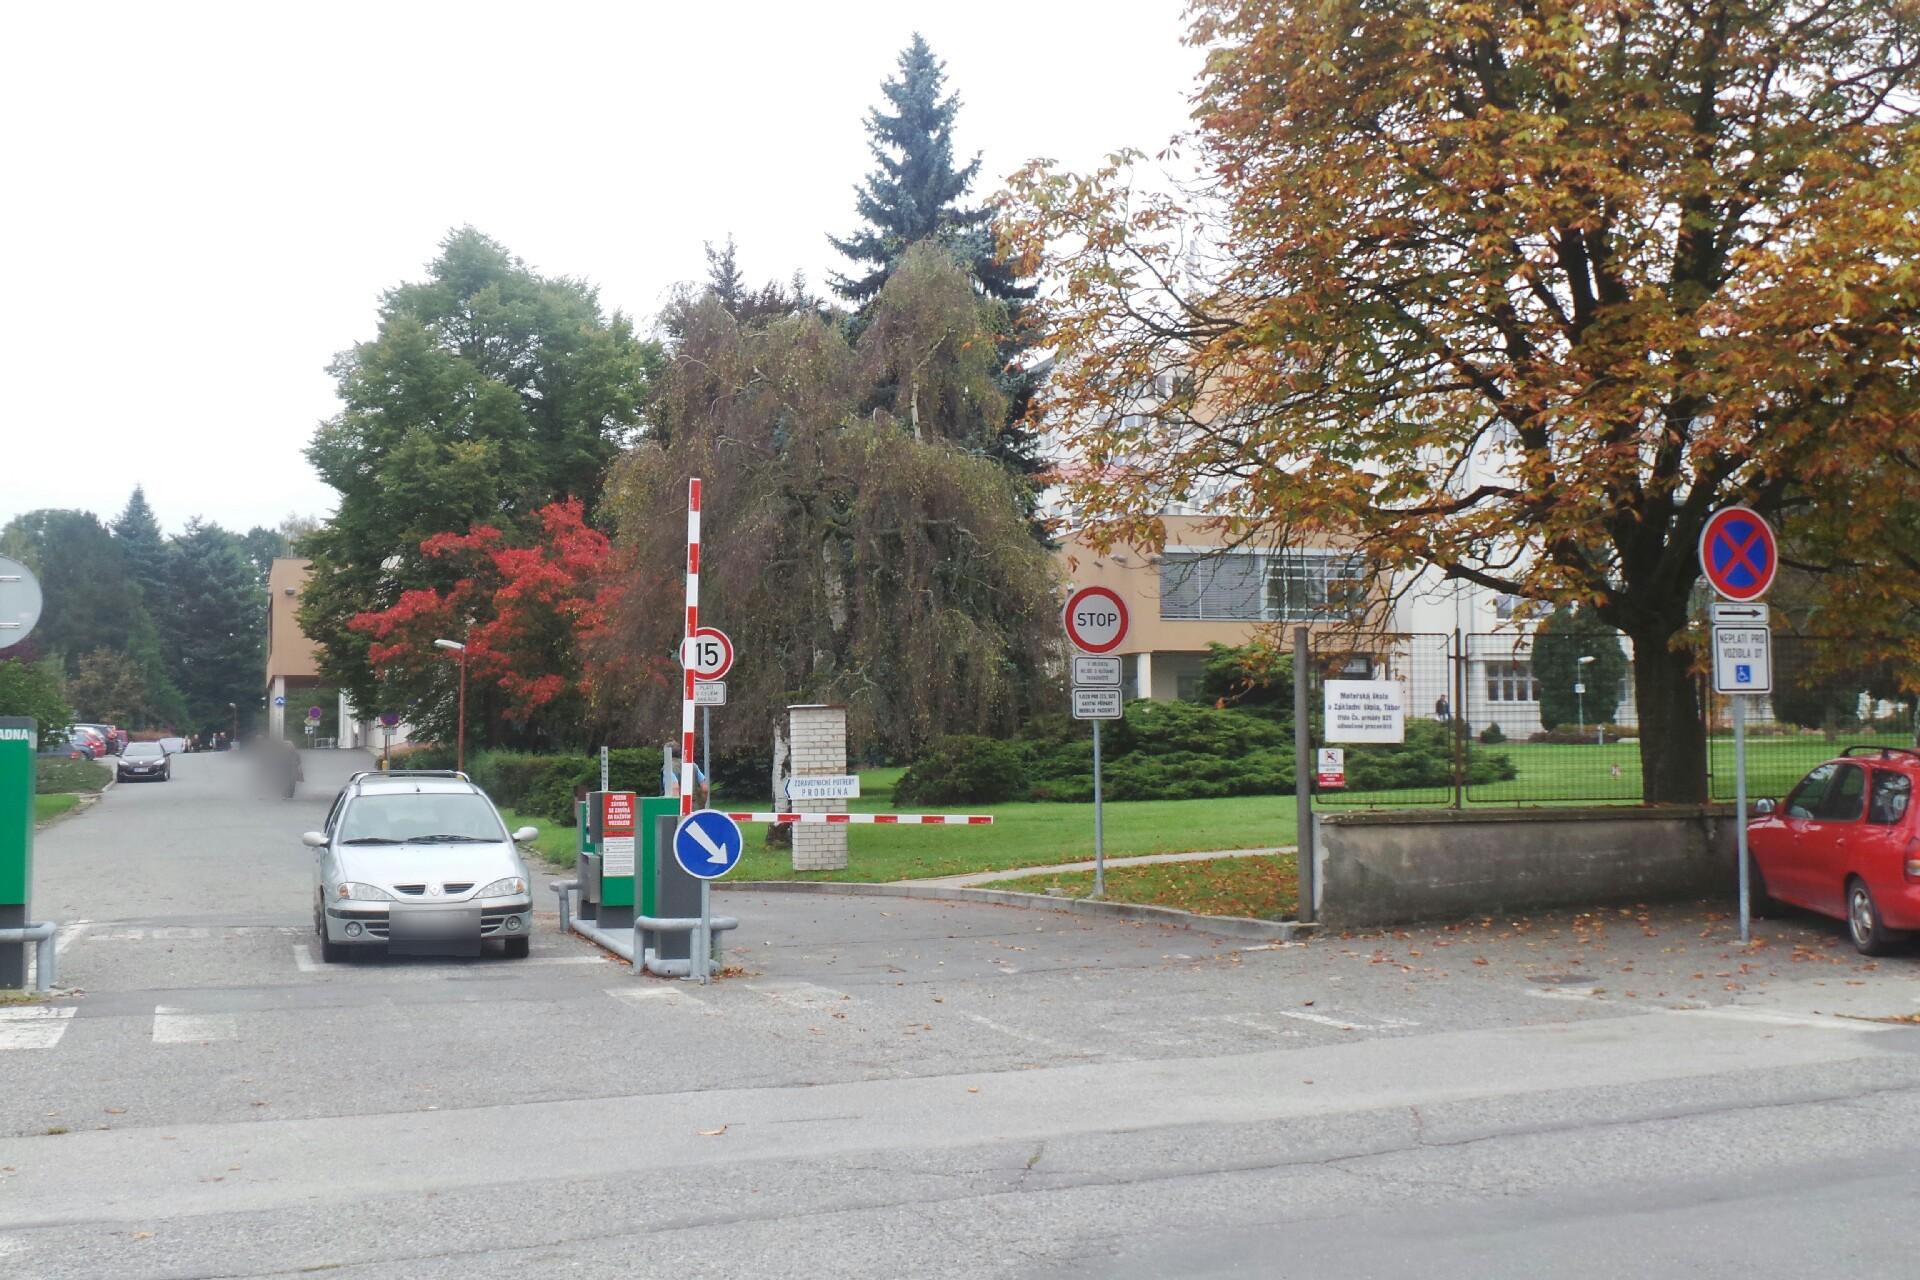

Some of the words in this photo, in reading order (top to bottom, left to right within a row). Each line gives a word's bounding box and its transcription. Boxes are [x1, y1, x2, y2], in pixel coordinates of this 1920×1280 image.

[1078, 613, 1117, 627] STOP
[1720, 633, 1747, 644] NEPLATÍ
[1751, 634, 1764, 643] PRO
[696, 643, 718, 666] 15
[1723, 648, 1752, 658] VOZIDLA
[795, 778, 831, 787] ZDRAVOTNICKÉ
[802, 787, 848, 796] PRODEJNA
